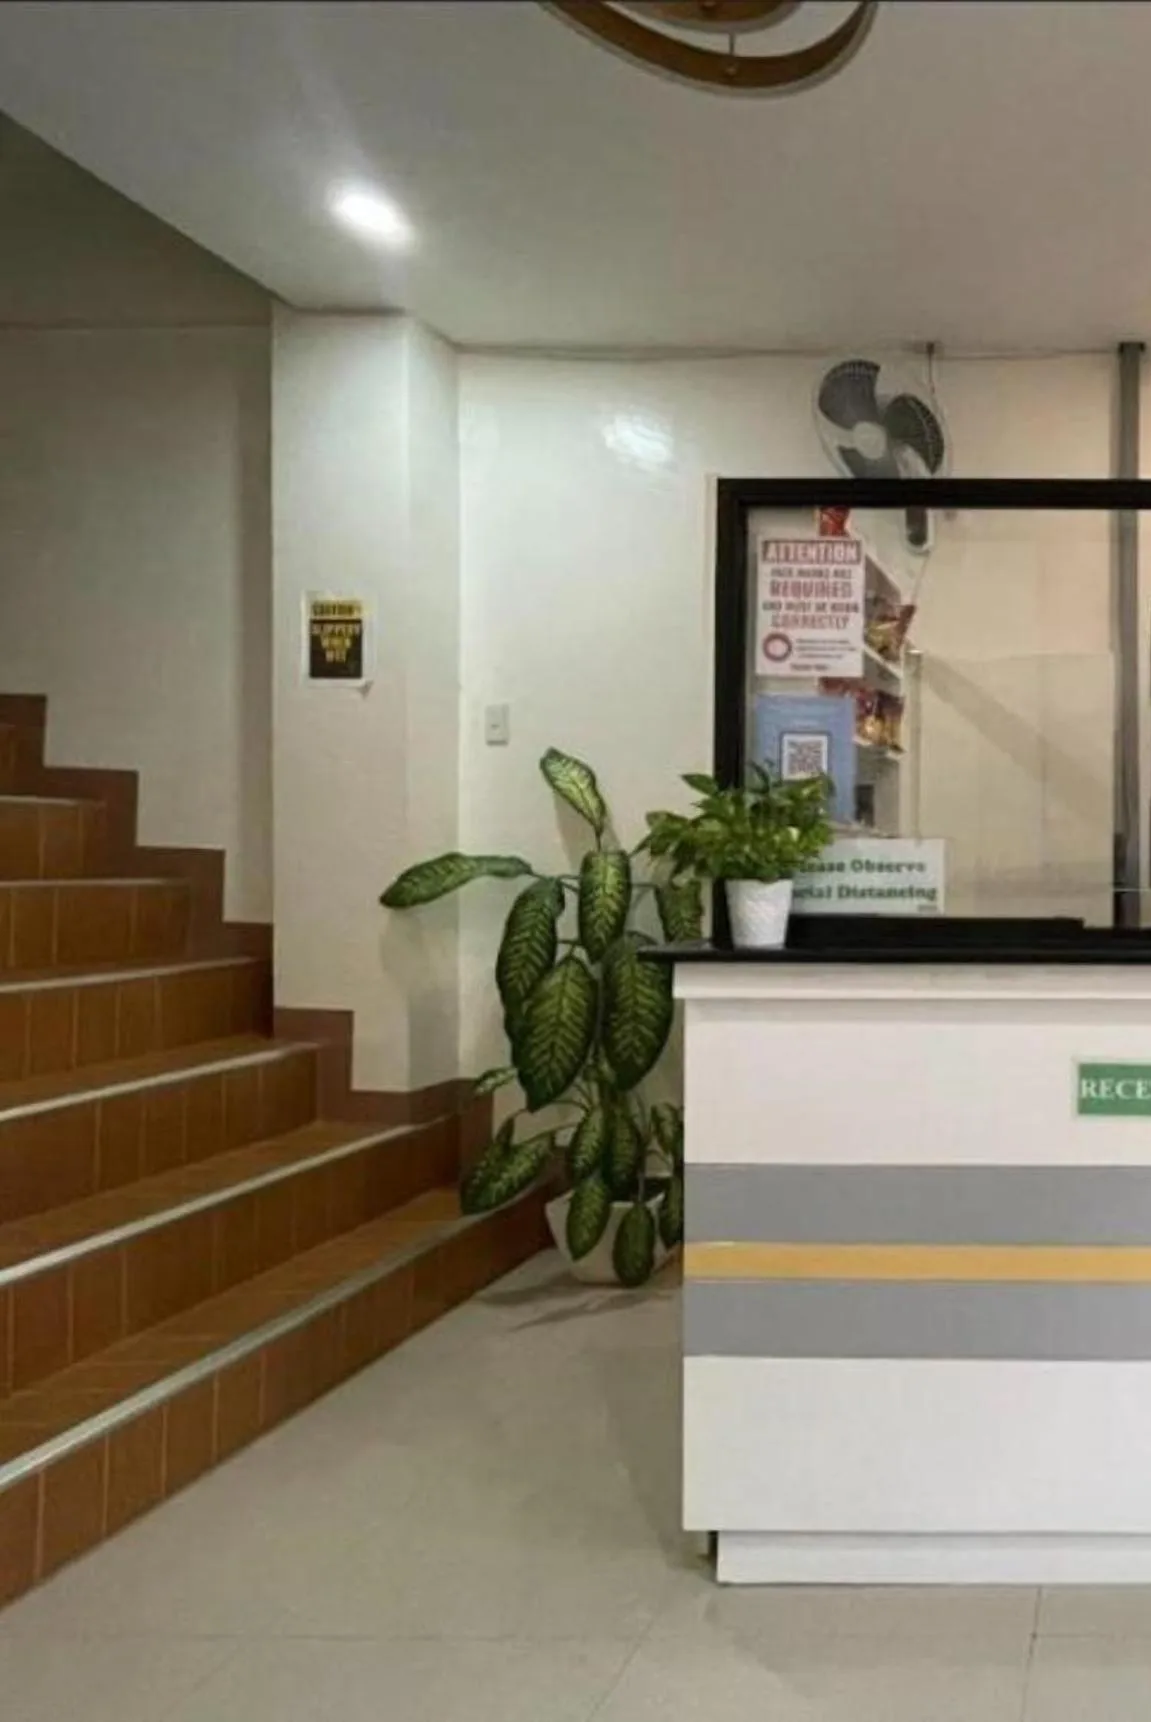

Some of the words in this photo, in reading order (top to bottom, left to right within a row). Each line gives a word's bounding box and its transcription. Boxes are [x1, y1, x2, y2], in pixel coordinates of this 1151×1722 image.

[765, 541, 858, 562] ATTENTION
[769, 580, 853, 599] REQUIRED
[769, 613, 850, 631] CORRECTLY
[850, 858, 927, 874] Observe
[837, 884, 938, 901] Distancing
